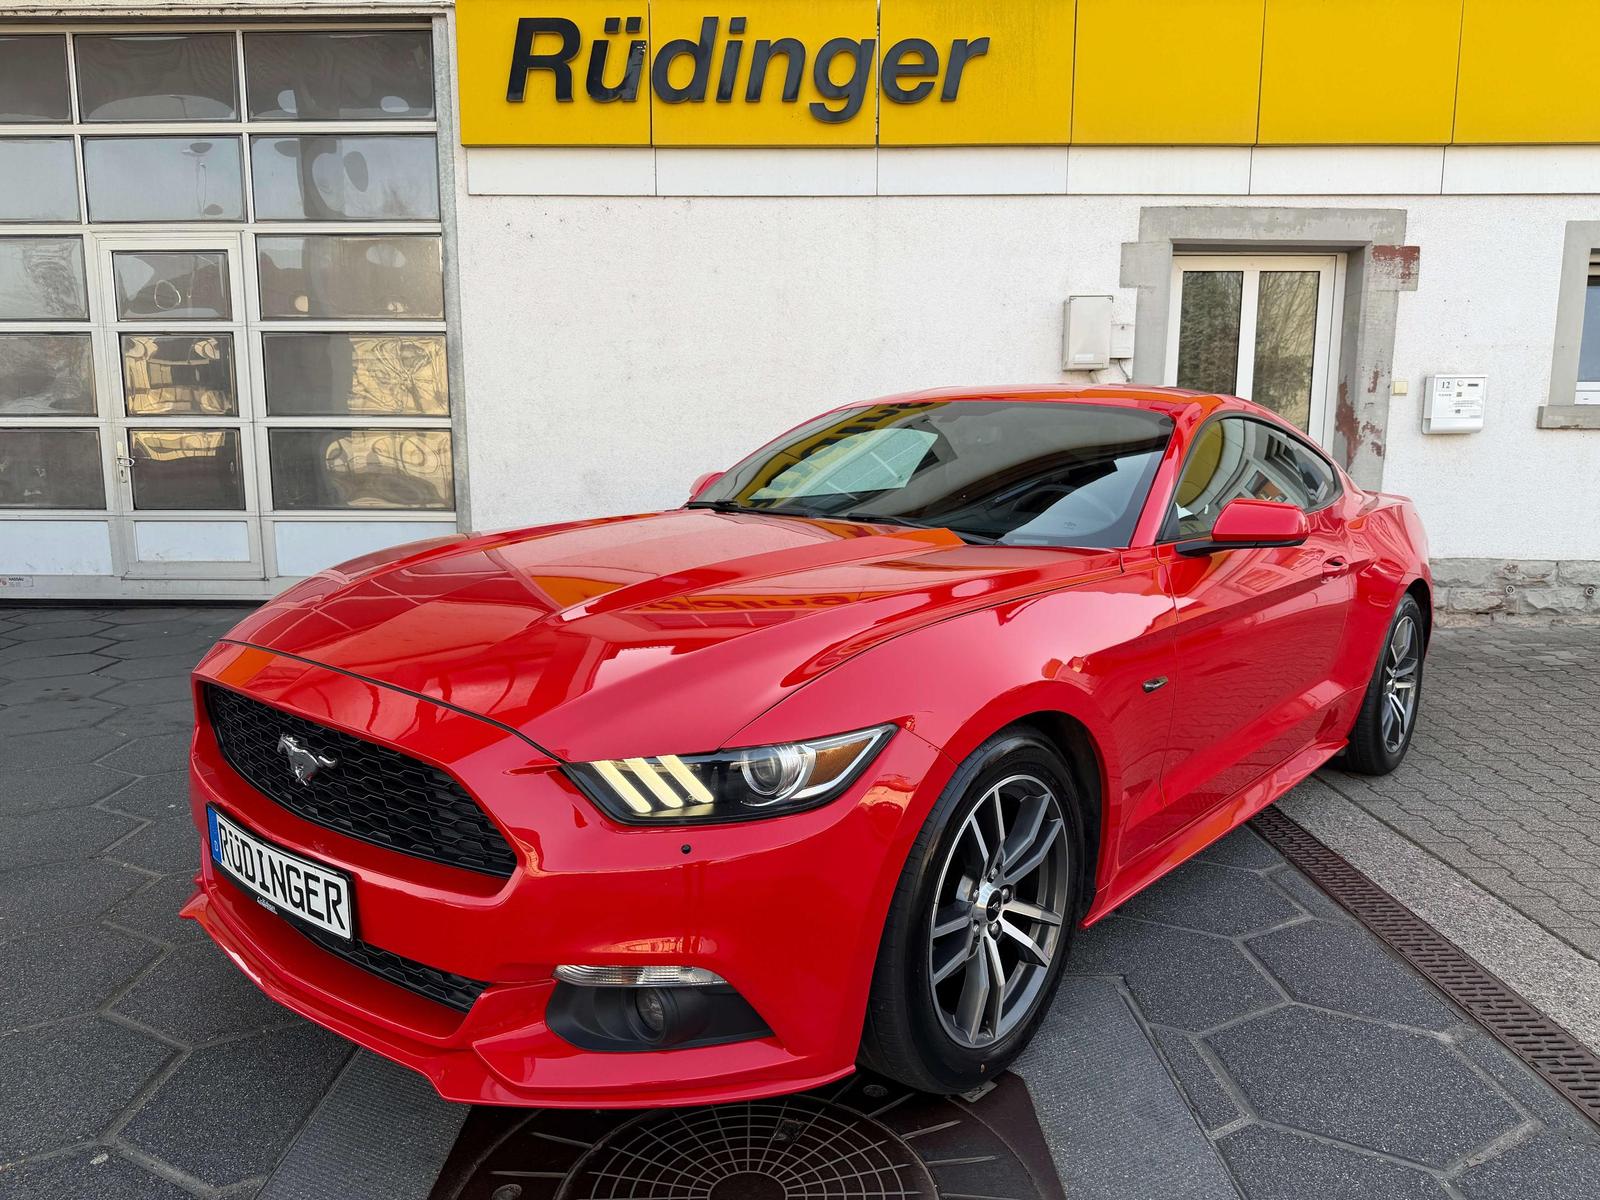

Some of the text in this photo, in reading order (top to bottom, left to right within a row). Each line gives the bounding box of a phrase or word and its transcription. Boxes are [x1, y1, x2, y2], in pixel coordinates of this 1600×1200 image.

[506, 17, 990, 123] Rüdinger
[1441, 381, 1451, 389] 12
[218, 822, 346, 931] RÜDINGER
